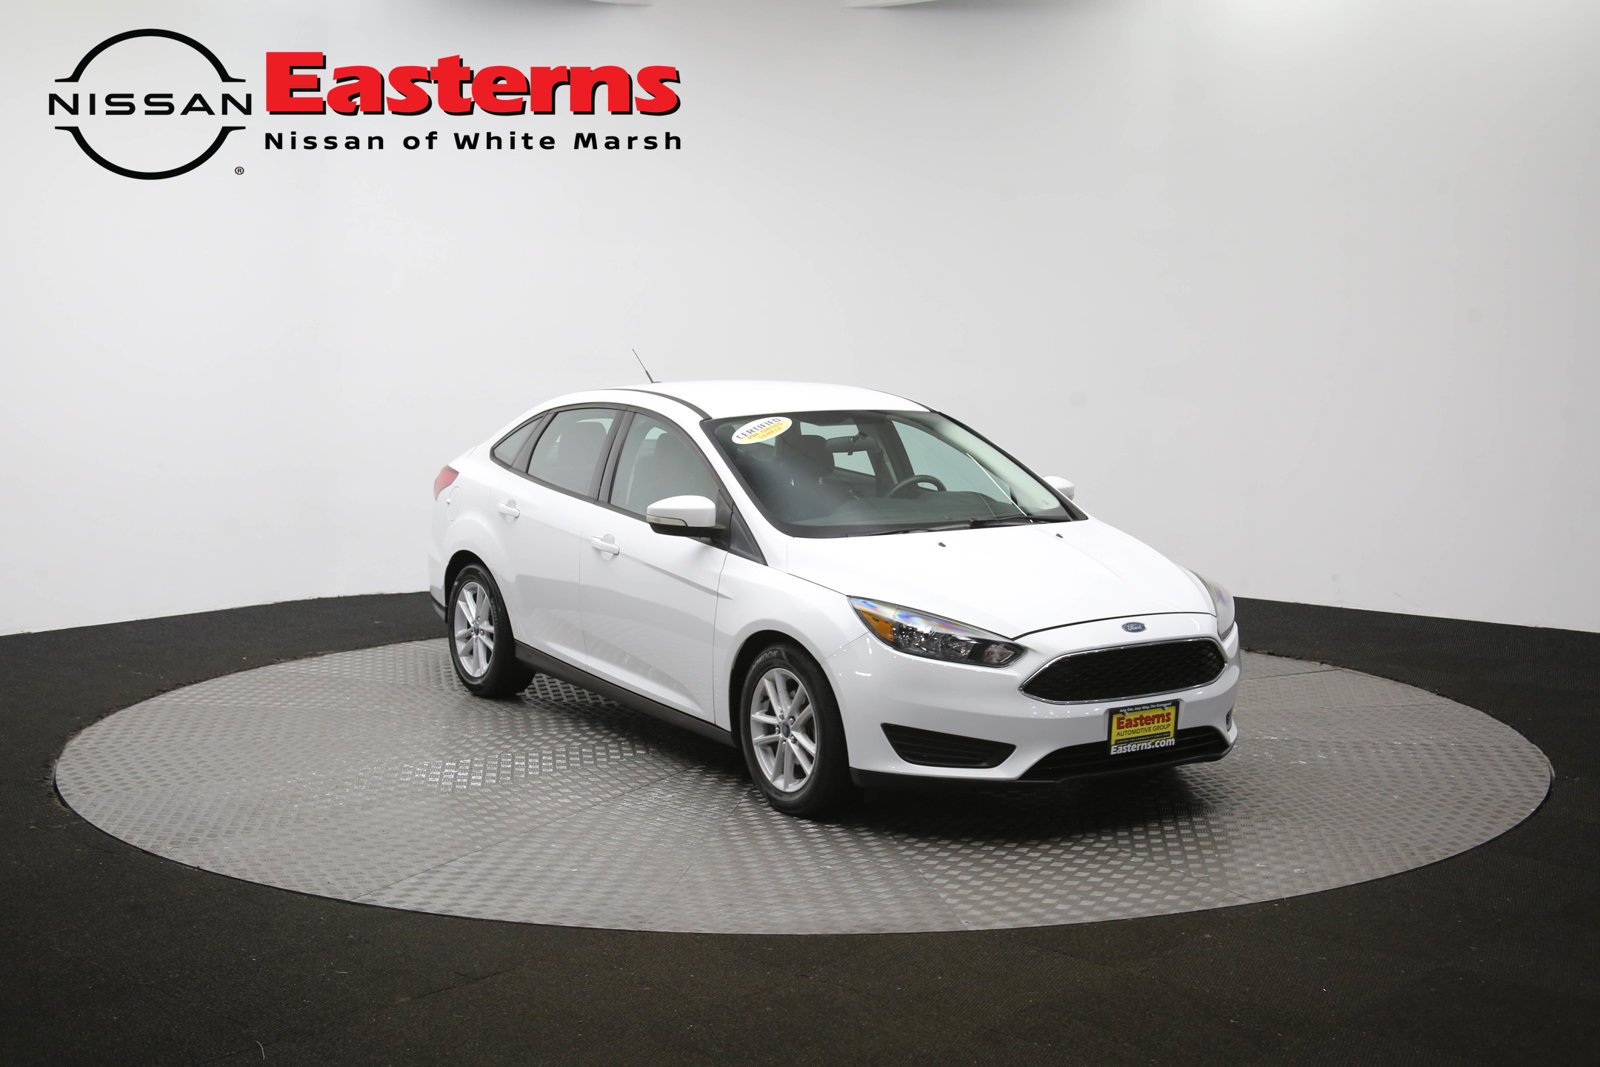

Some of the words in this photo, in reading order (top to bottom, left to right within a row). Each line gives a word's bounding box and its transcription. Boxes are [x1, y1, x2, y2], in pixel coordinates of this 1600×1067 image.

[736, 417, 781, 440] CERTIFIED
[1116, 712, 1171, 729] Easterns
[1116, 726, 1151, 736] AUTOMOTIVE
[1152, 724, 1171, 732] GROUP
[1110, 737, 1175, 755] Easterns.com
